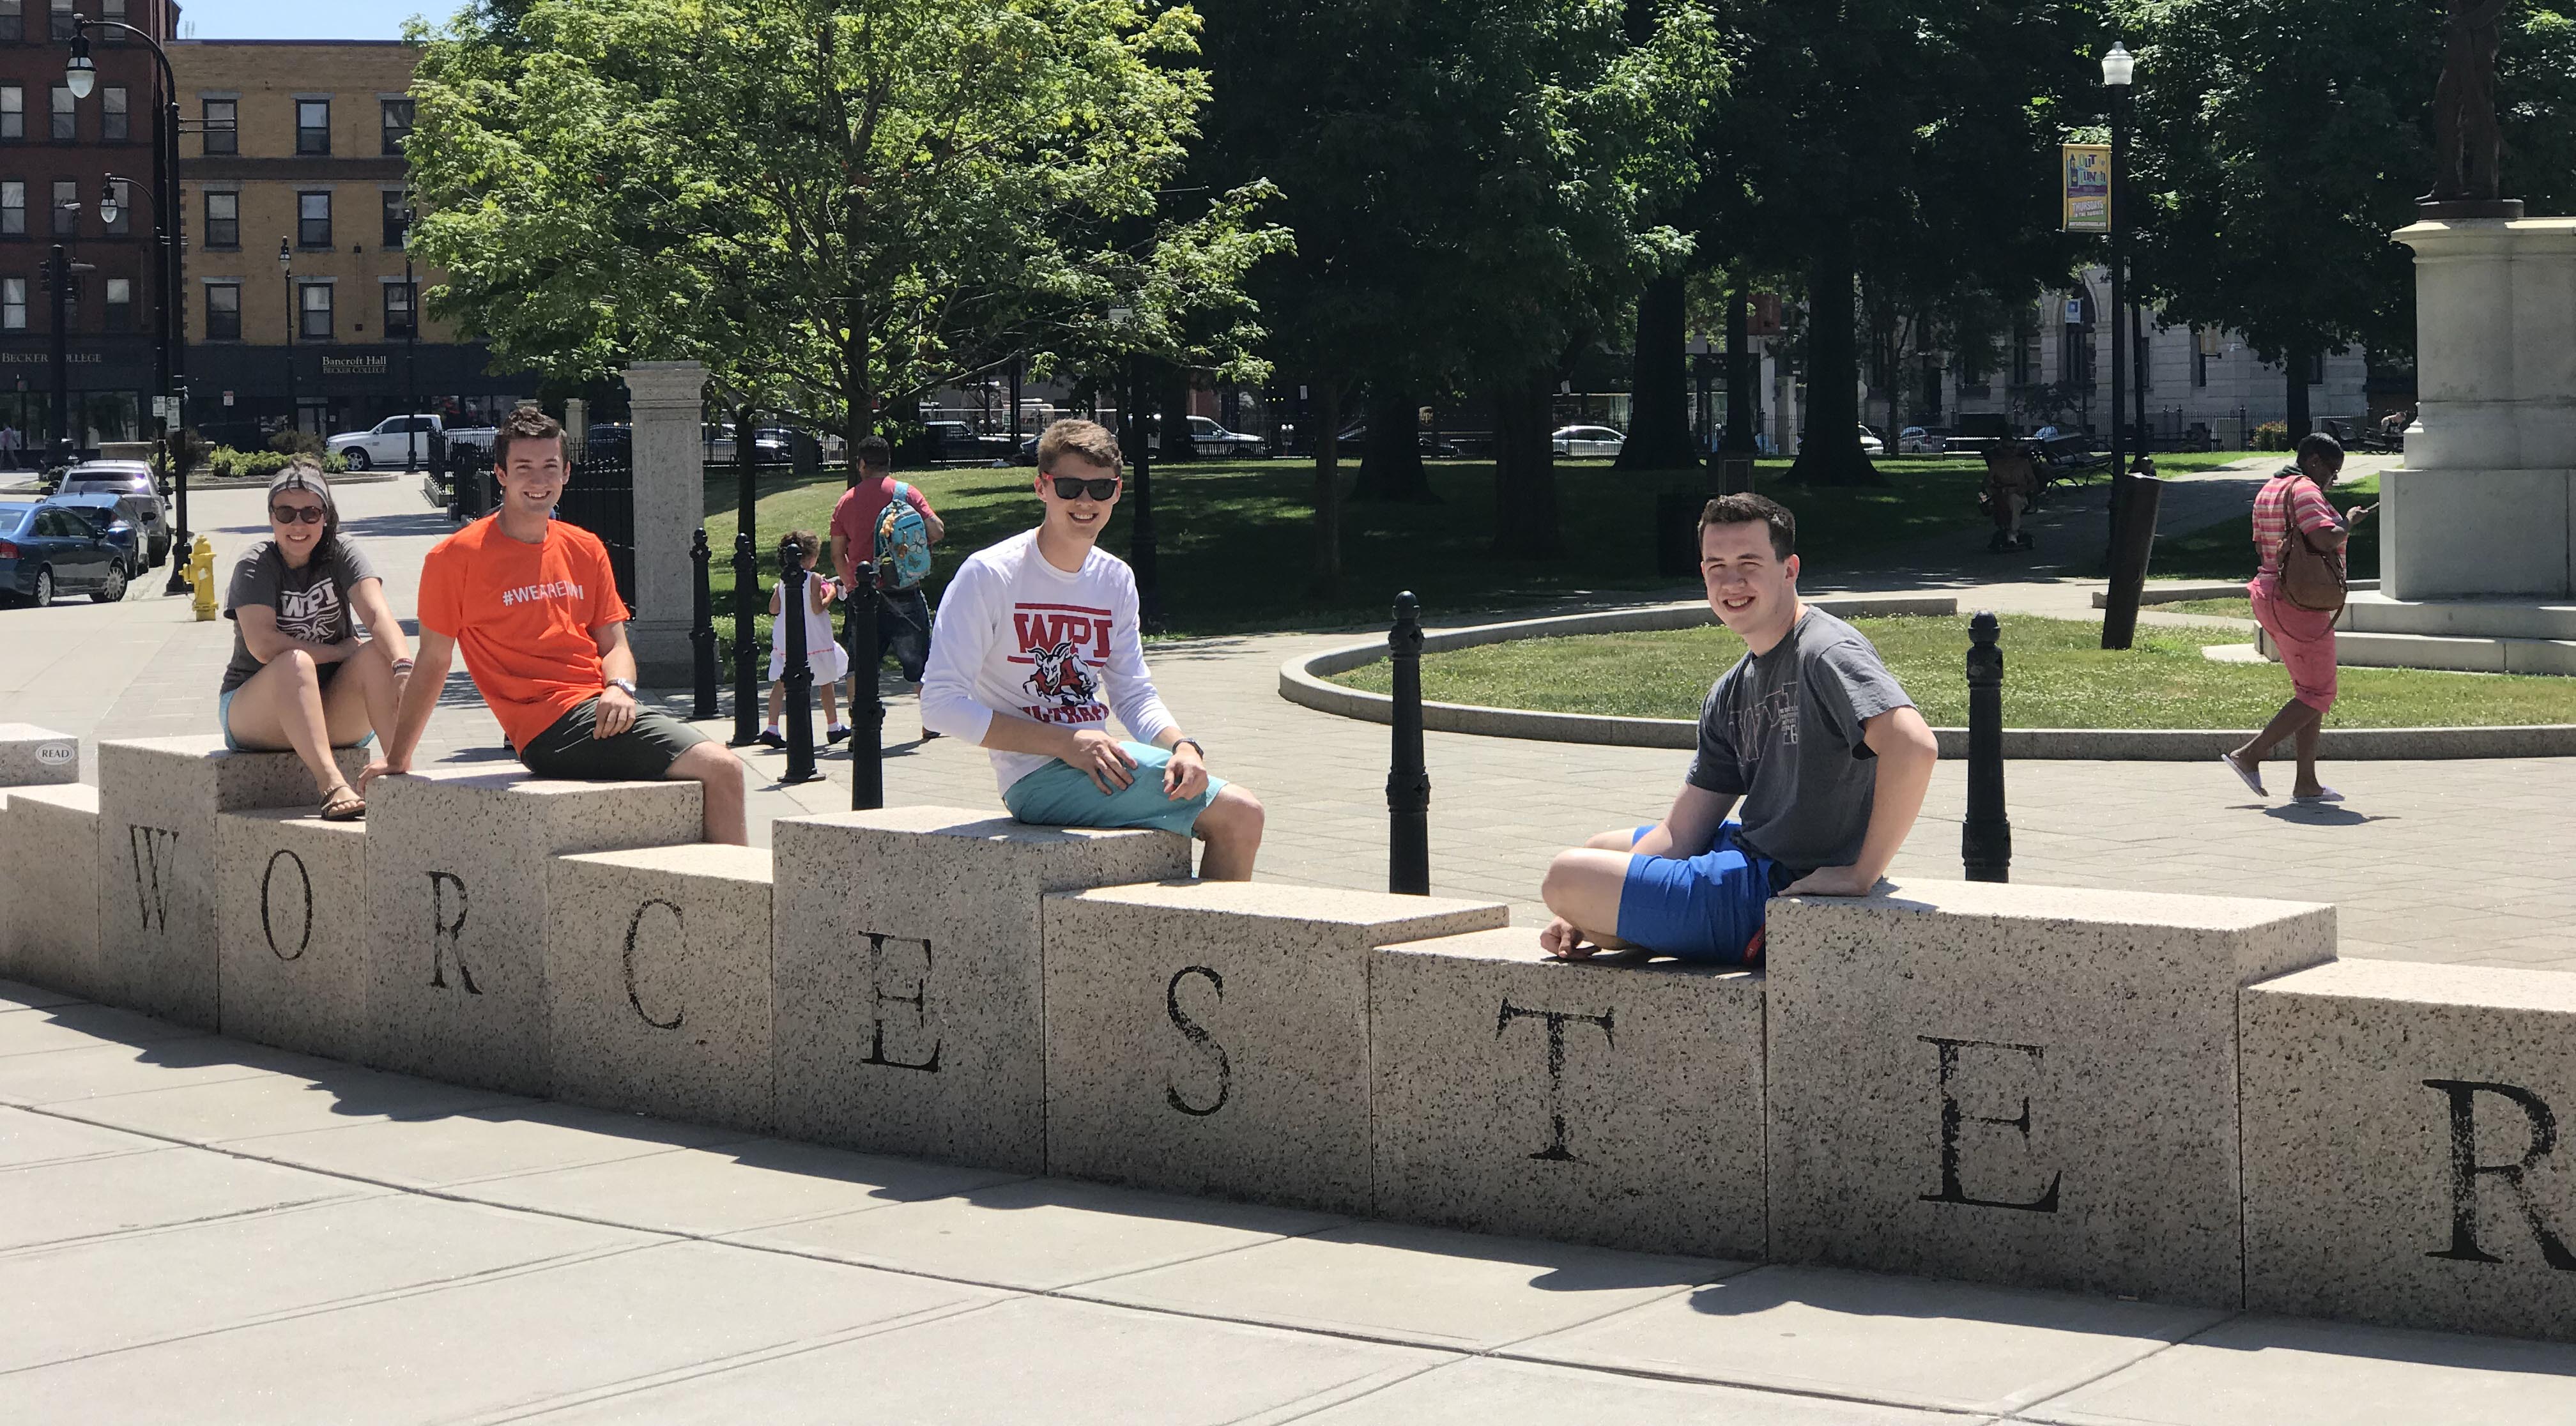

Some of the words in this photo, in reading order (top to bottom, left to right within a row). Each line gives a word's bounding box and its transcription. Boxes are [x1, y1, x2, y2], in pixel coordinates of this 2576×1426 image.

[2, 353, 49, 362] BECKER
[66, 354, 102, 362] LLEGE
[323, 356, 362, 365] Bancroft
[366, 356, 386, 365] Hall
[280, 583, 338, 617] WPI
[503, 580, 584, 606] #WEAREWI
[1014, 613, 1112, 657] WPI
[42, 749, 69, 758] READ
[130, 823, 2575, 1272] WORCESTER
